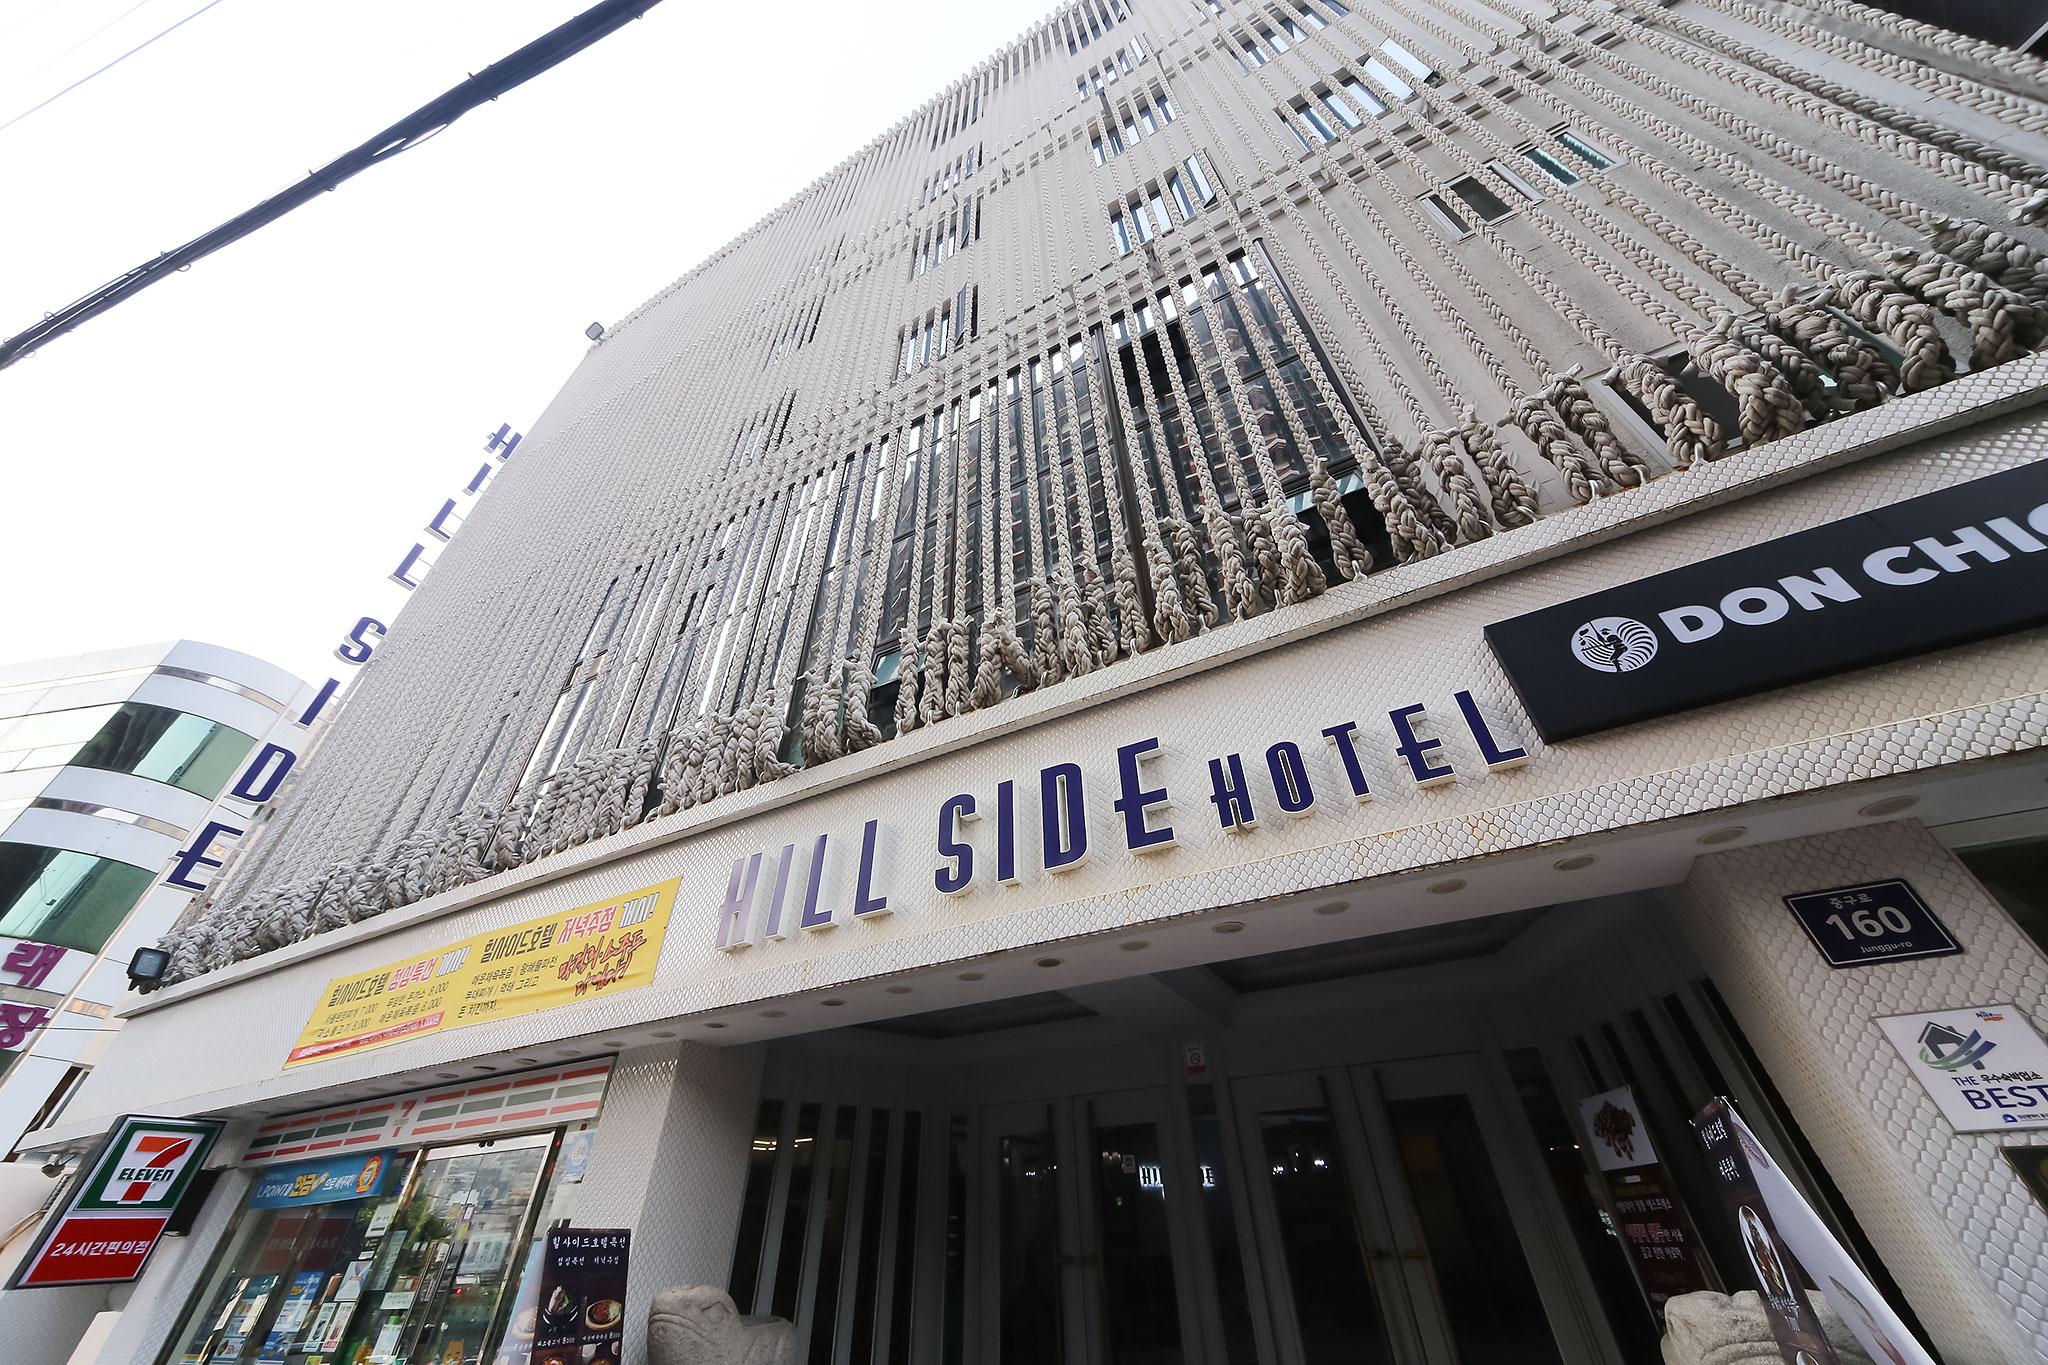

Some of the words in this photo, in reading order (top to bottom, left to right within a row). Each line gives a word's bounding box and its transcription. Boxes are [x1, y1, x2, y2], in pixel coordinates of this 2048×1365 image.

[394, 423, 522, 590] HILL
[1658, 566, 1862, 644] DON
[164, 616, 387, 892] SIDE
[716, 818, 888, 950] HILL
[934, 736, 1176, 895] SIDE
[1209, 690, 1528, 830] HOTEL
[1829, 892, 1873, 910] 중구로
[480, 922, 558, 963] 힐사이드호텔
[557, 905, 618, 945] 저녁주점
[1825, 906, 1912, 940] 160
[1, 942, 69, 989] 래
[1860, 940, 1913, 954] Junggu-ro
[328, 971, 392, 1007] 힐사이드호텔
[387, 956, 439, 992] 점심특선
[515, 976, 540, 991] 그리고
[1951, 1075, 1980, 1087] THE
[1979, 1070, 2044, 1084] 우수숙박업소
[1960, 1084, 2048, 1110] BEST
[50, 1240, 151, 1258] 24시간편의점
